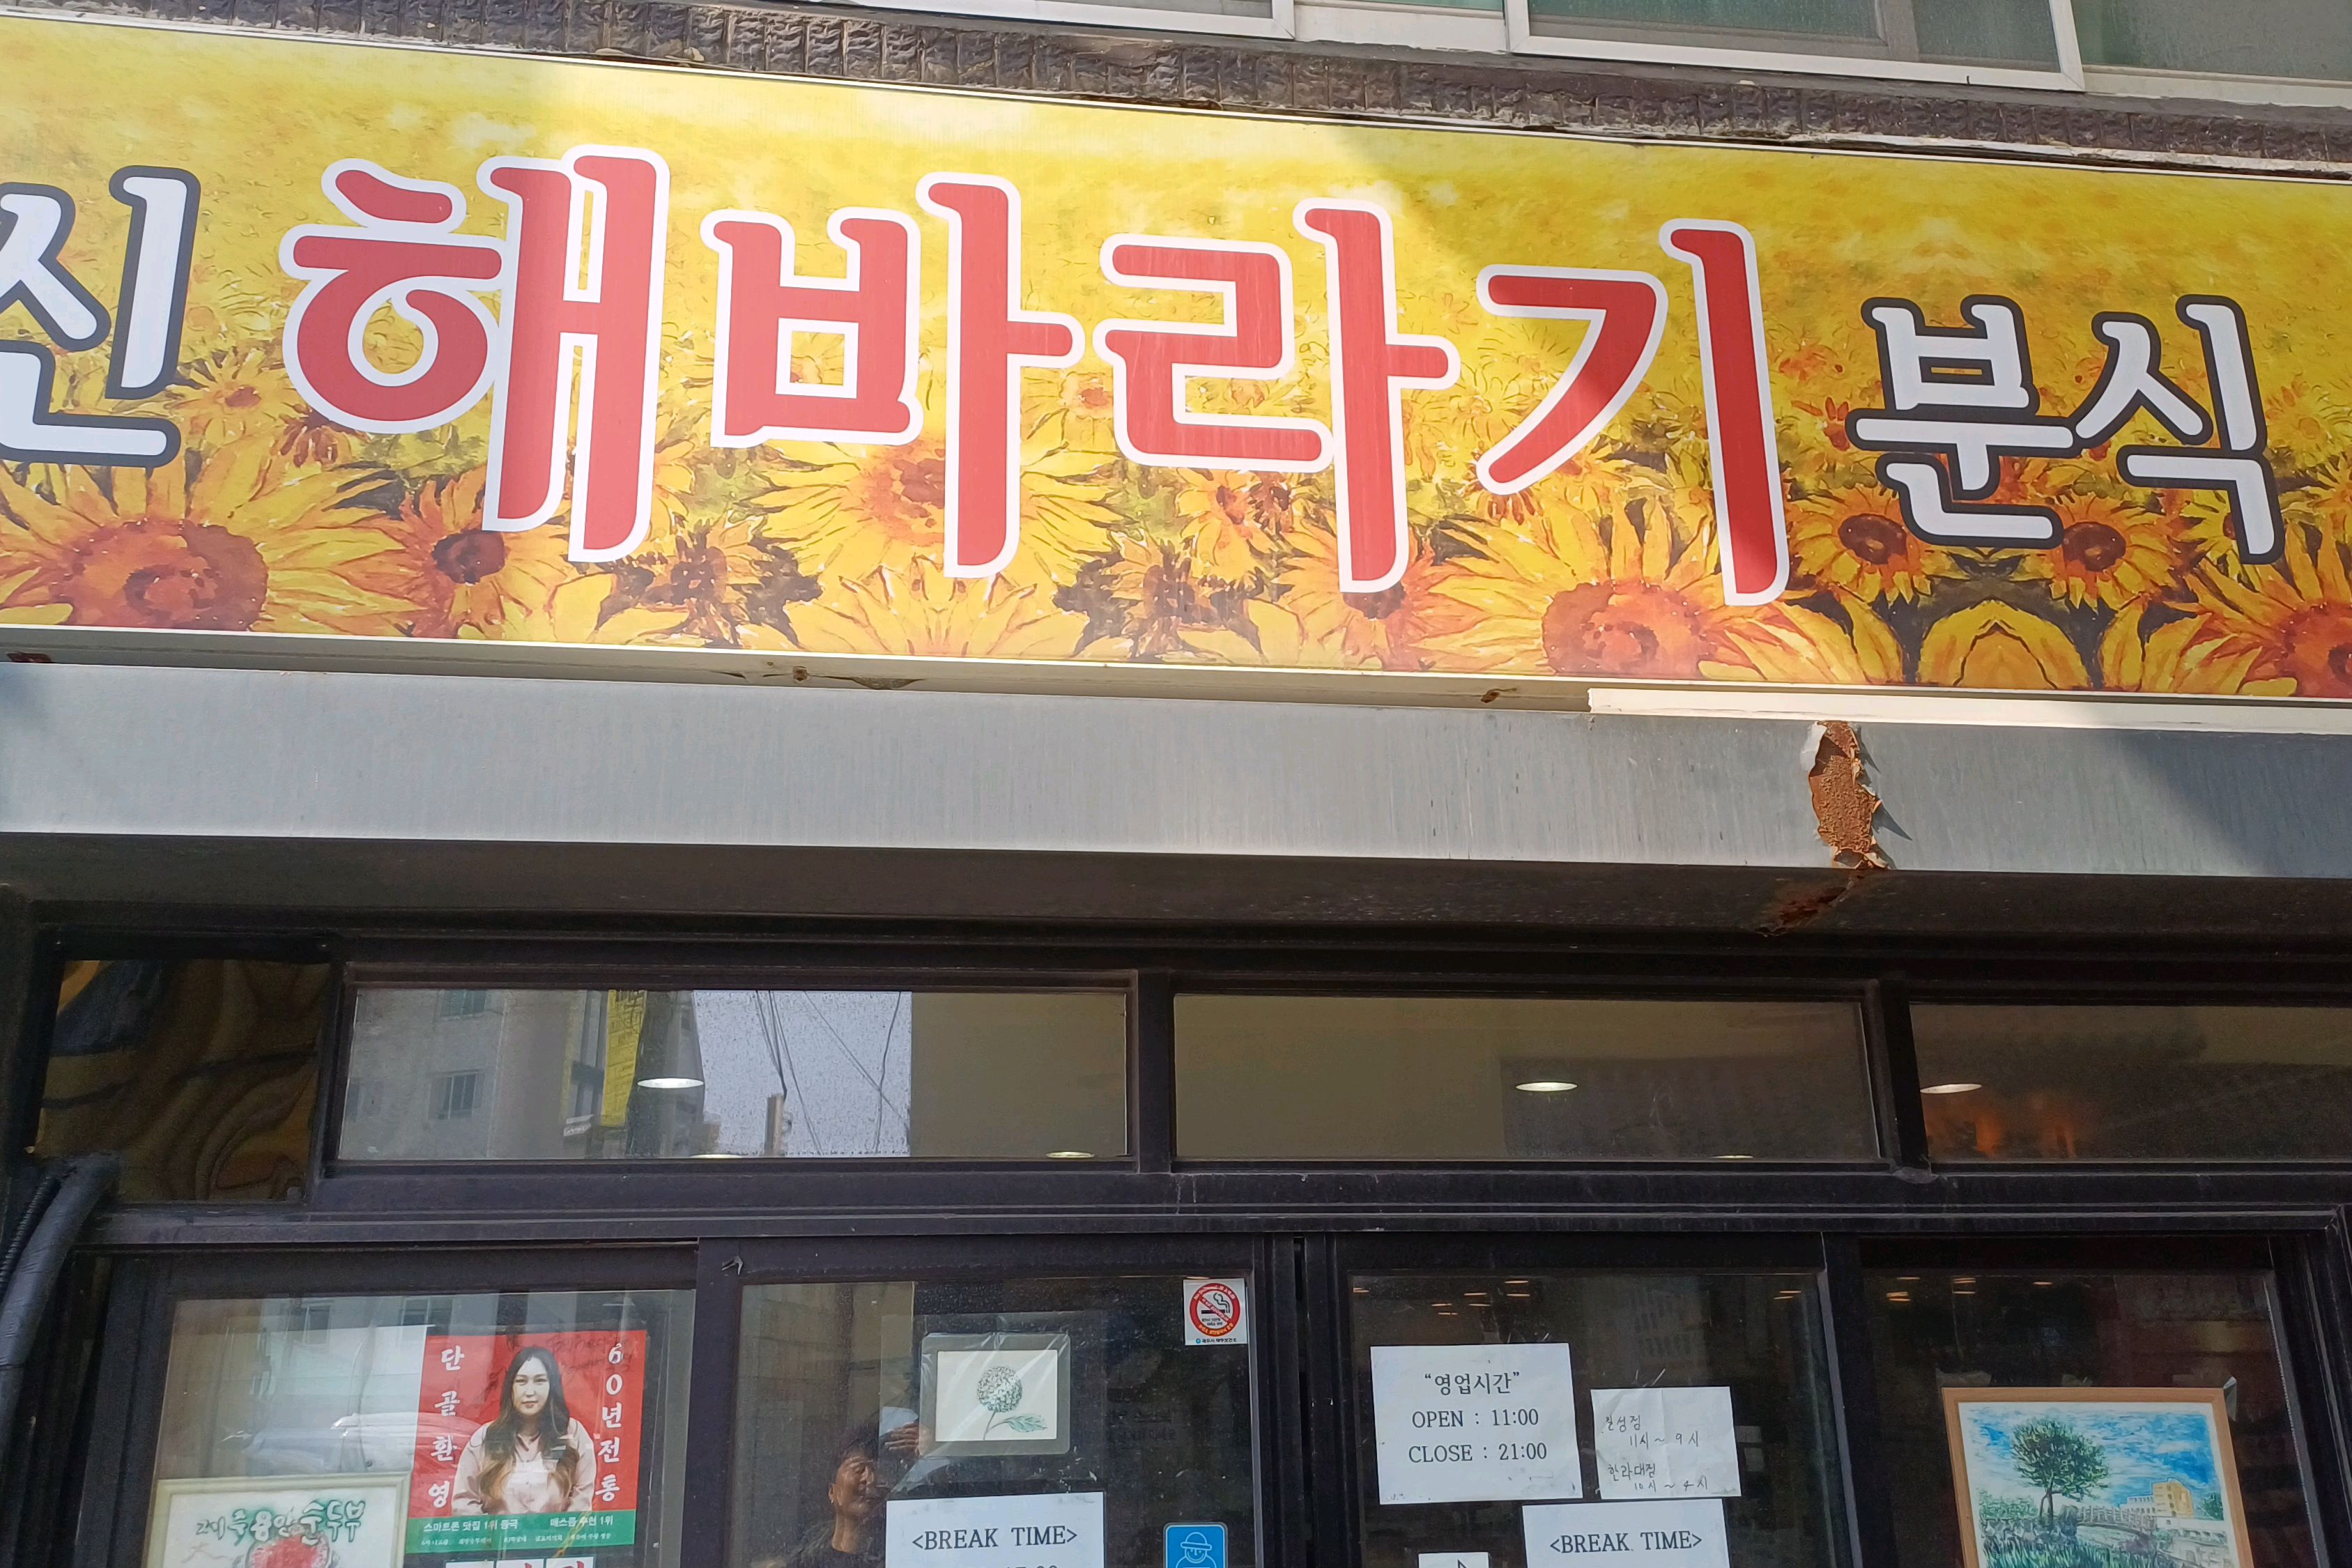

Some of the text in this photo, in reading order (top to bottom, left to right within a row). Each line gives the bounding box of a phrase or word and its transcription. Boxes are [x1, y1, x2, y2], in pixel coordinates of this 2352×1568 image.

[279, 144, 1790, 608] 해바라기
[1845, 294, 2286, 565] 분식
[1412, 1410, 1463, 1429] OPEN
[1492, 1408, 1539, 1427] 11:00
[1408, 1444, 1473, 1463] CLOSE
[1498, 1442, 1548, 1461] 21:00
[912, 1525, 1078, 1551] <BREAK TIME>
[1640, 1530, 1702, 1551] TIME>
